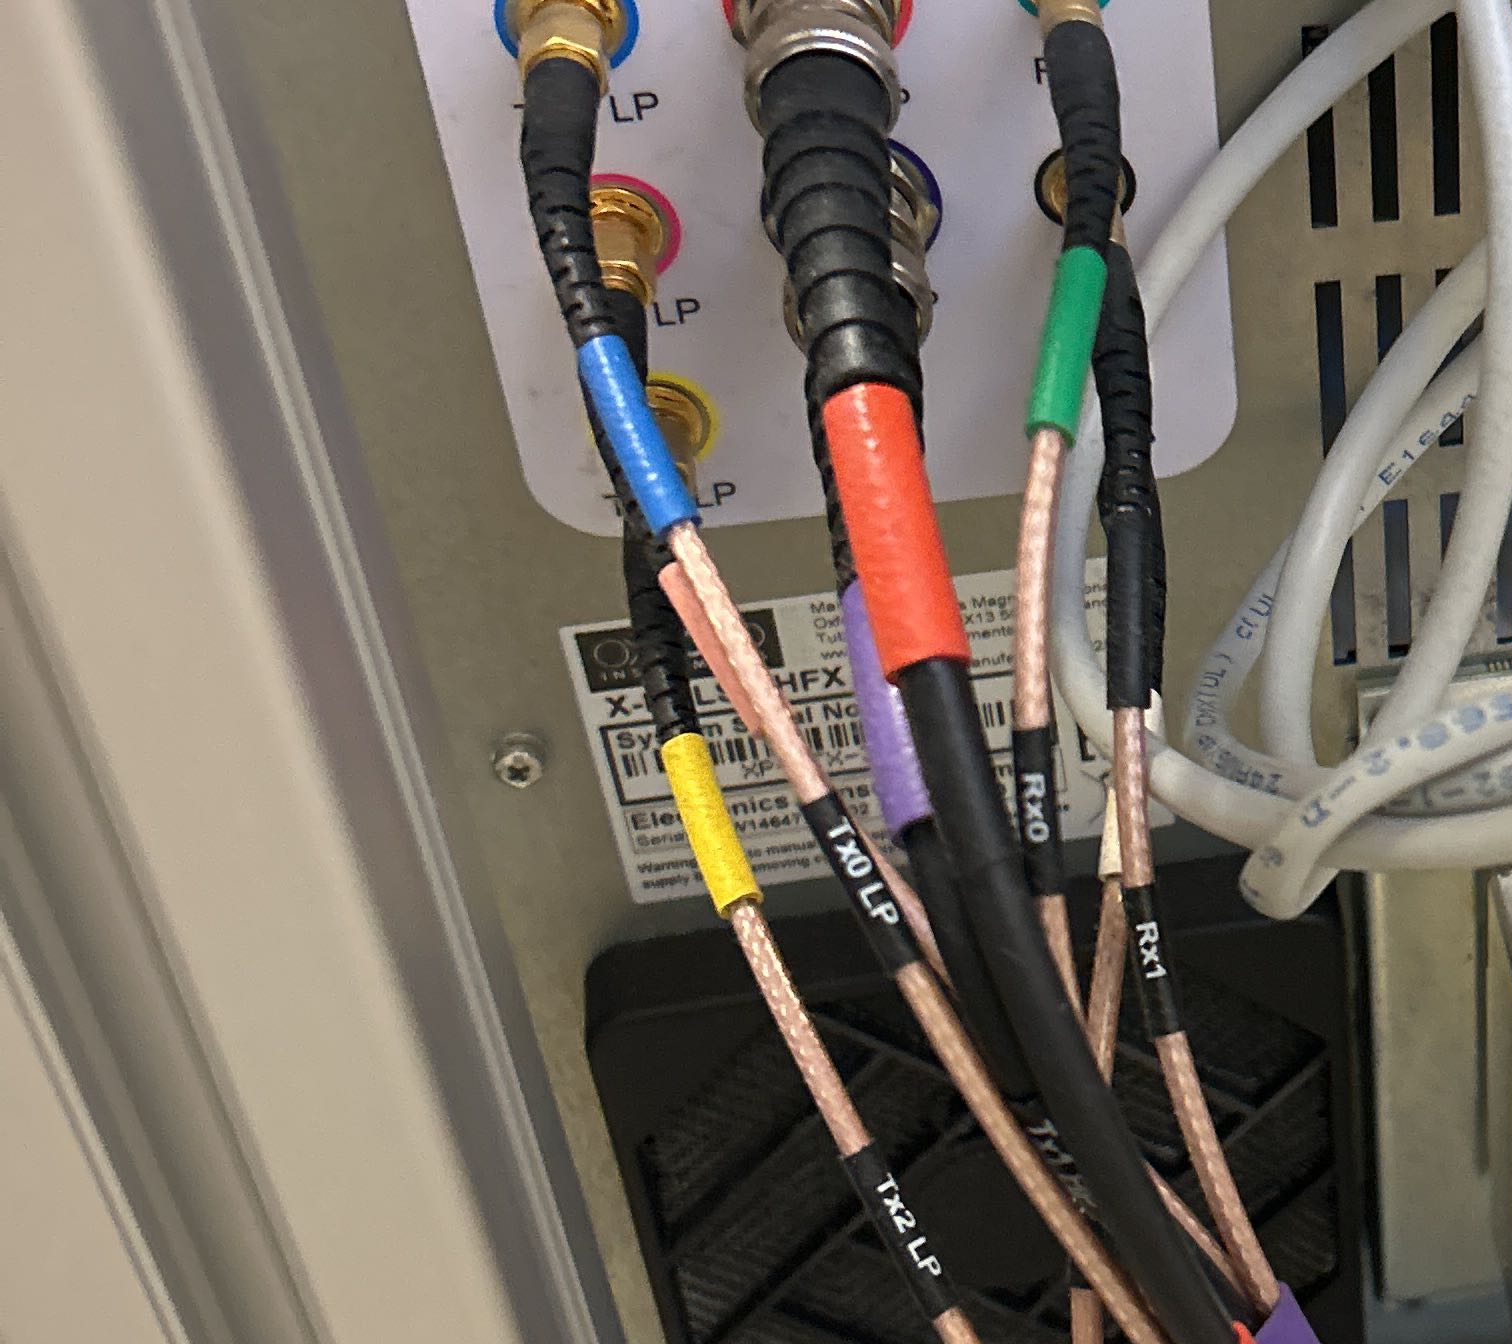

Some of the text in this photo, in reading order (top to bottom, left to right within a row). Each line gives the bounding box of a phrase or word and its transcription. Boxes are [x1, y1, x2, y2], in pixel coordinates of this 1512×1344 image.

[610, 90, 659, 124] LP
[655, 297, 701, 328] LP
[694, 480, 737, 510] LP
[826, 816, 874, 879] Tx0
[856, 881, 900, 926] LP
[1134, 920, 1166, 980] Rx1
[876, 1173, 943, 1281] Tx2 LP
